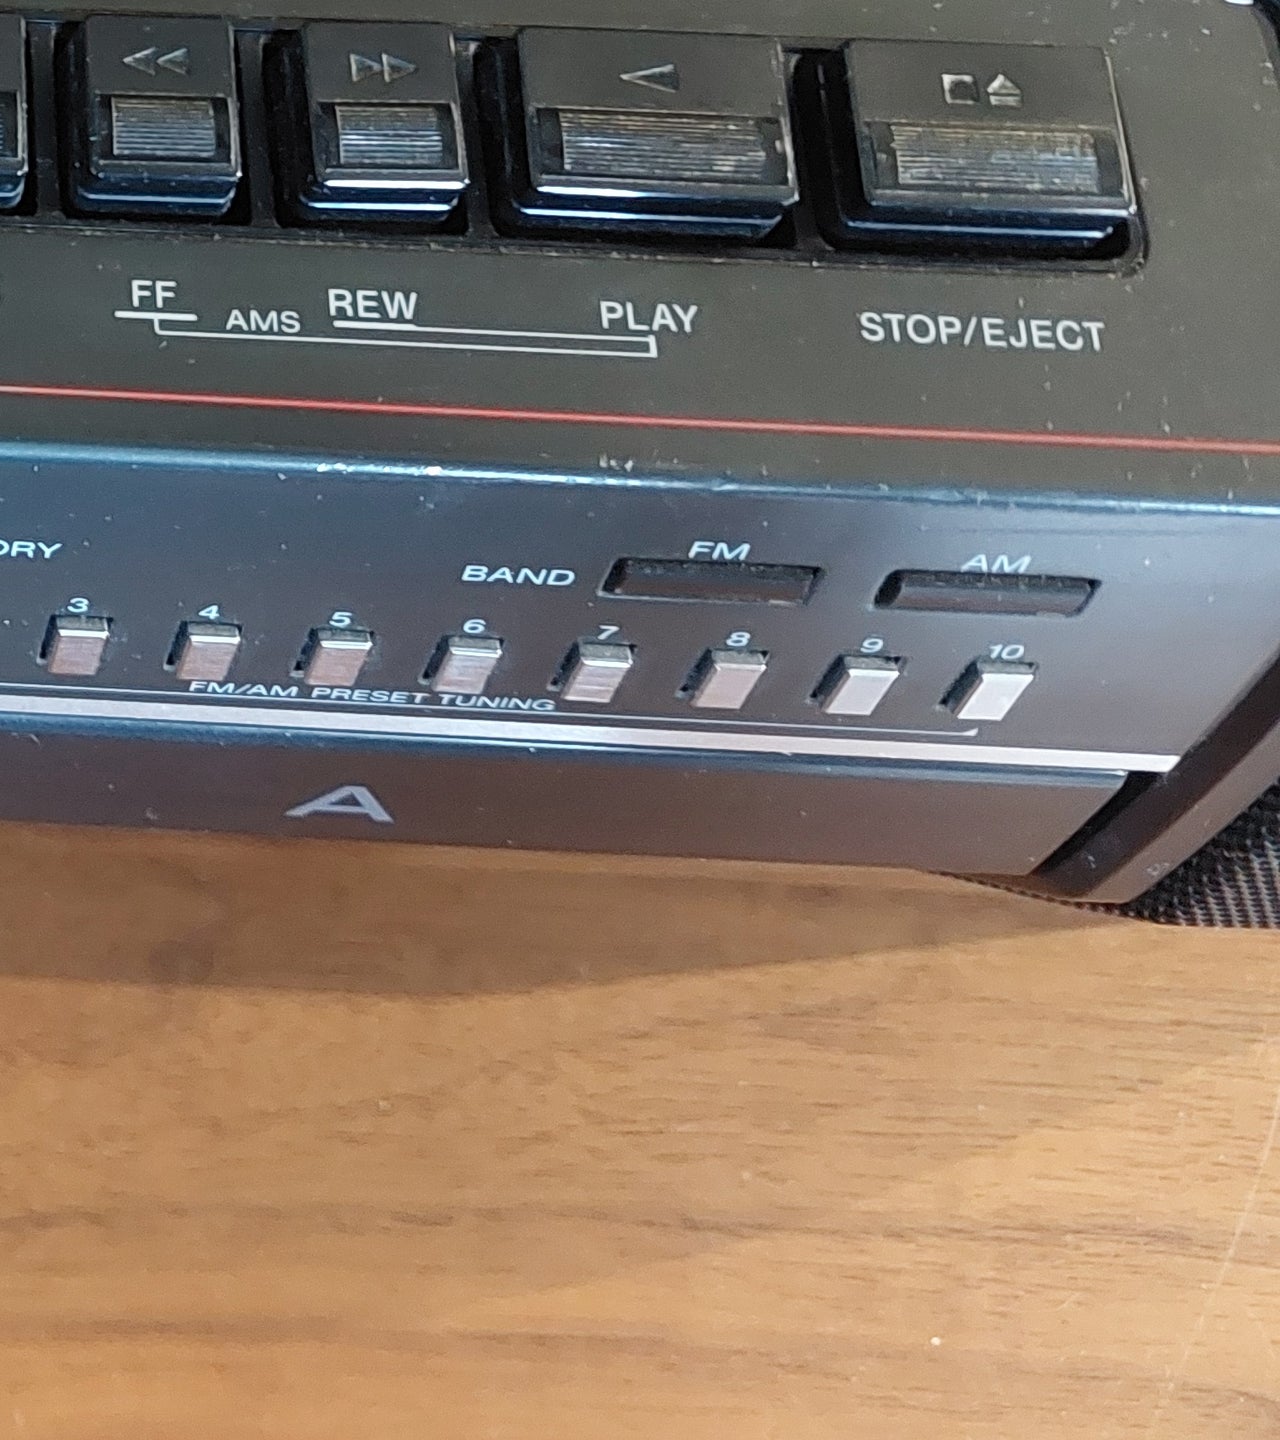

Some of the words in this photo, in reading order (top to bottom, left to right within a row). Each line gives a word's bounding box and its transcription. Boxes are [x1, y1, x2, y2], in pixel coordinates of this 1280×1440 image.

[131, 279, 178, 308] FF
[328, 289, 418, 320] REW
[225, 309, 301, 333] AMS
[600, 301, 698, 333] PLAY
[859, 311, 1105, 350] STOP/EJECT
[689, 542, 750, 560] FM
[960, 554, 1032, 572] AM
[461, 564, 576, 587] BAND
[66, 597, 90, 613] 3
[196, 604, 221, 620] 4
[329, 610, 354, 628] 5
[462, 618, 486, 634] 6
[598, 626, 619, 640] 7
[725, 631, 751, 648] 8
[860, 638, 886, 654] 9
[989, 644, 1025, 661] 10
[187, 681, 299, 699] FM/AM
[310, 687, 430, 705] PRESET
[438, 692, 556, 712] TUNING
[285, 785, 396, 824] A
